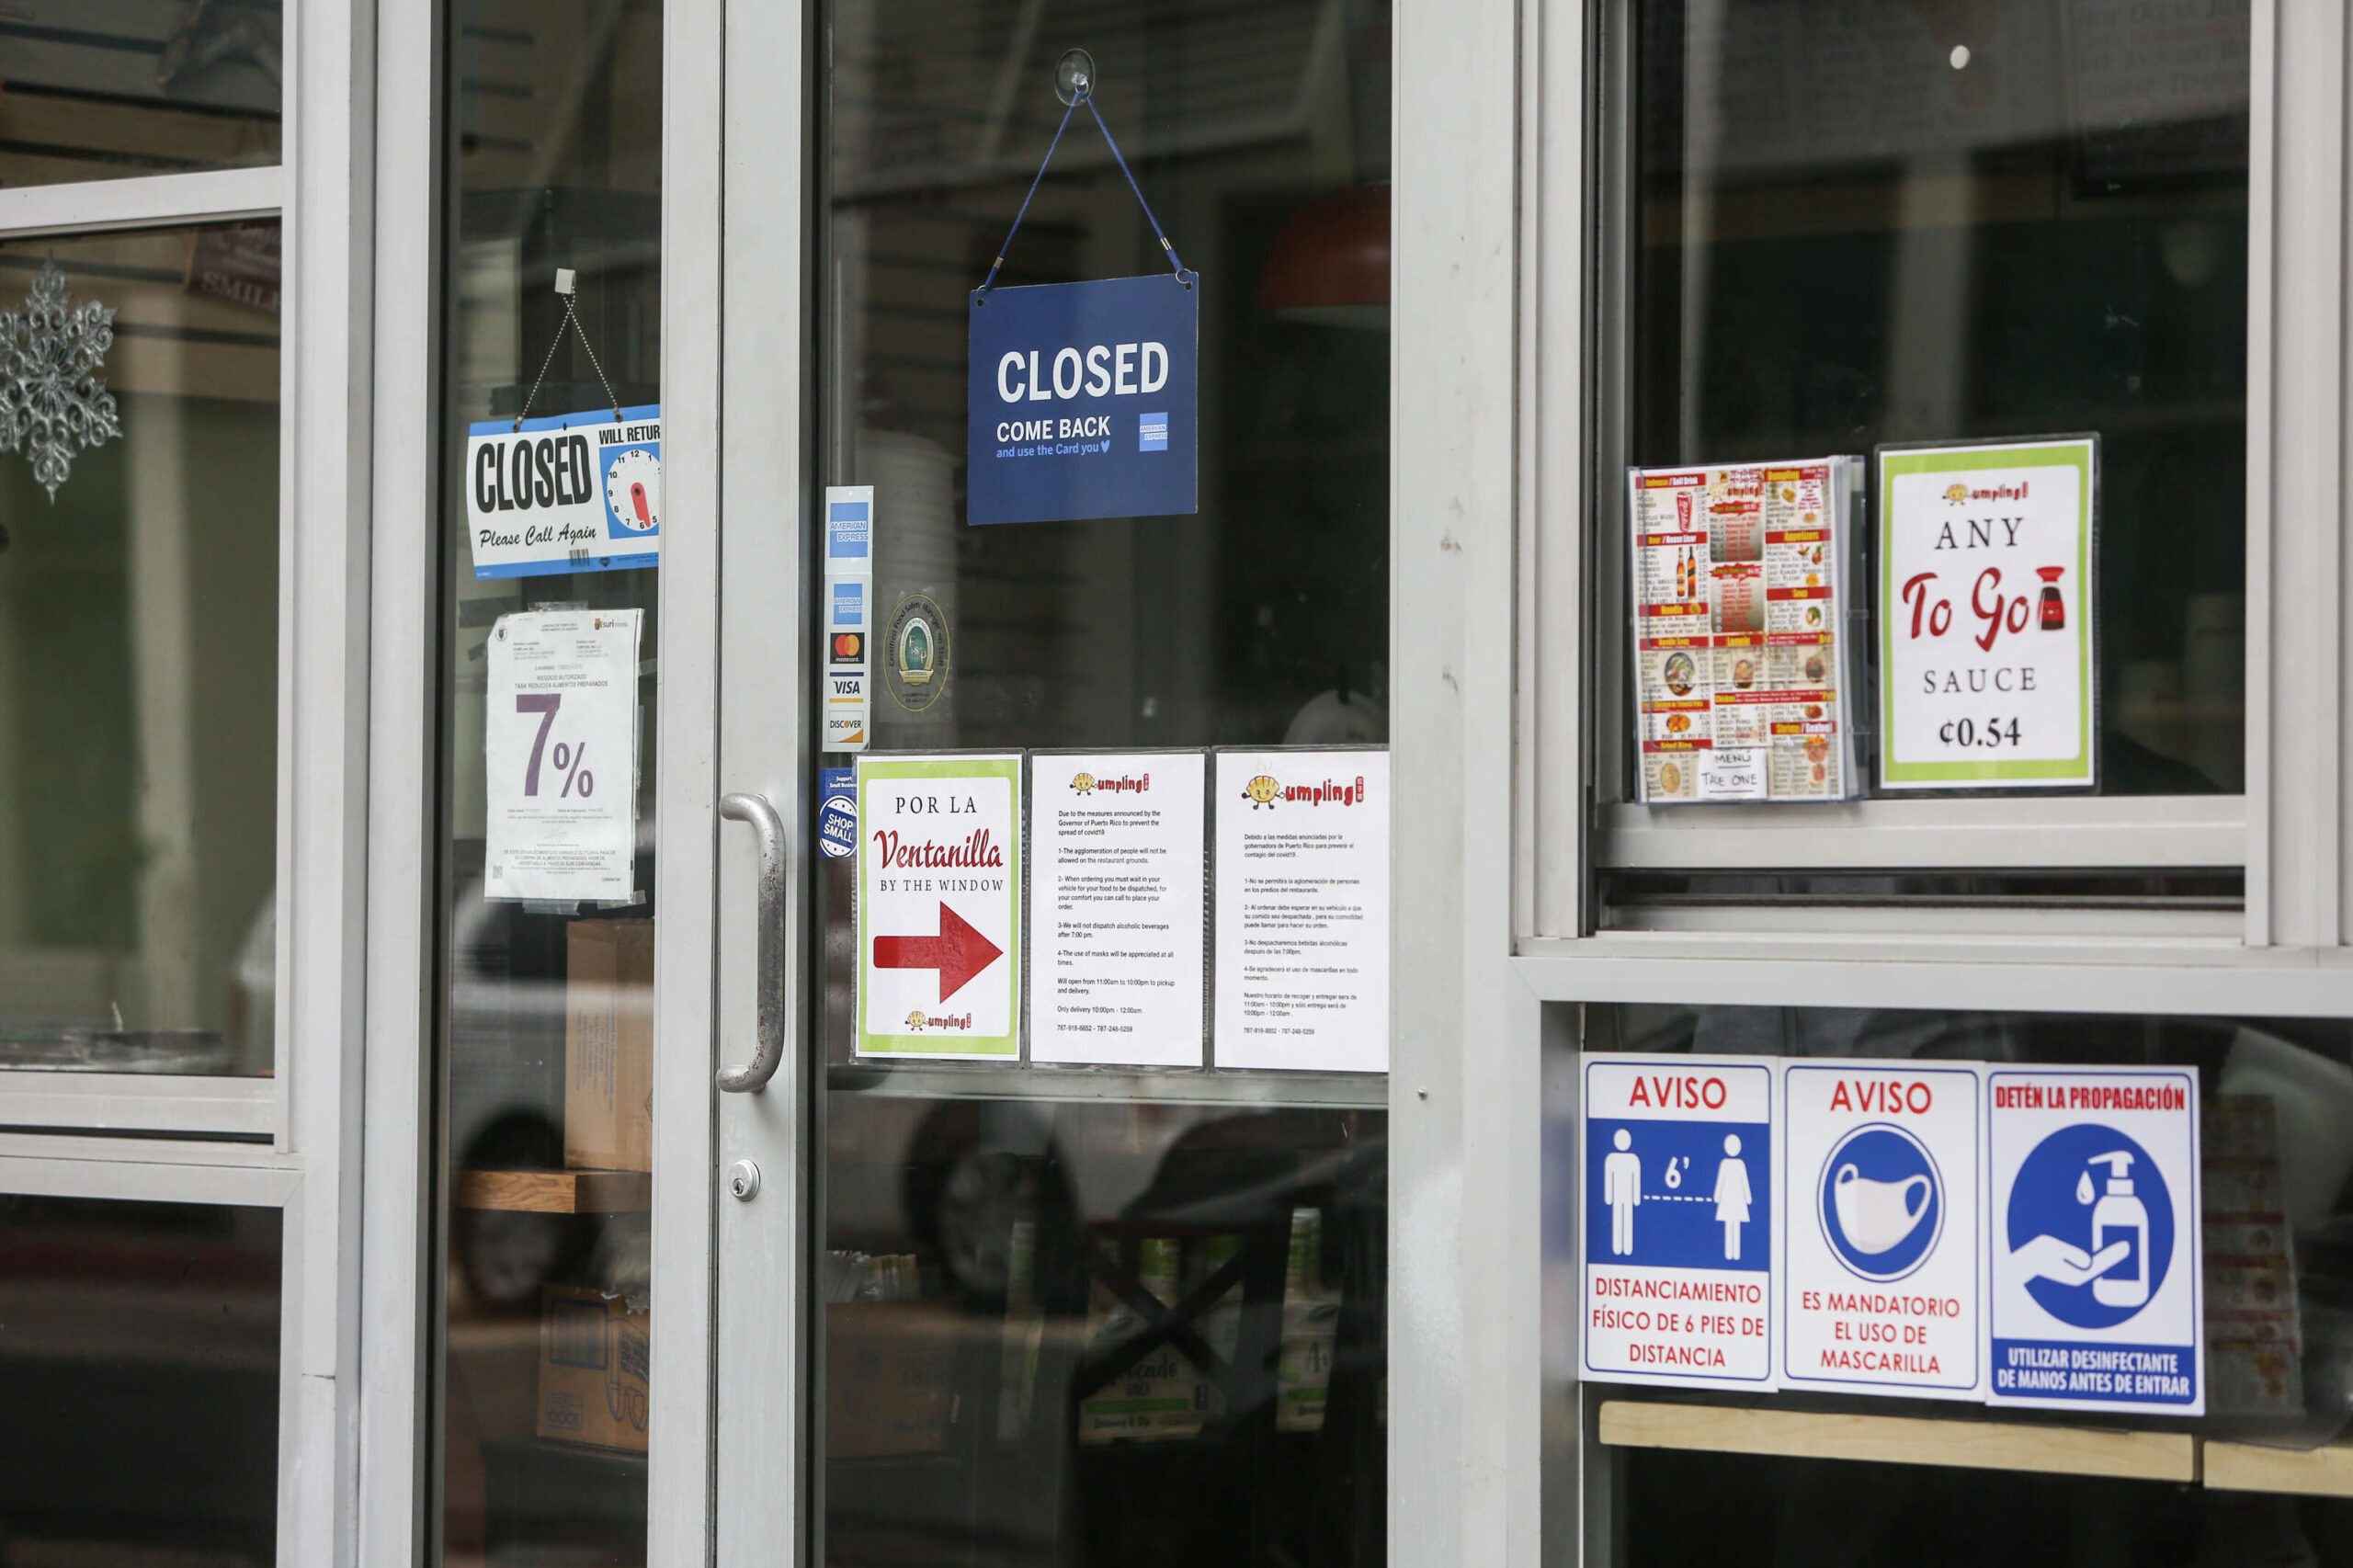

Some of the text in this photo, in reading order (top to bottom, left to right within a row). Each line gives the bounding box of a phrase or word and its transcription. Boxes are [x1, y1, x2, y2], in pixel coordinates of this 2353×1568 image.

[997, 342, 1169, 403] CLOSED
[599, 428, 624, 445] WILL
[996, 416, 1111, 442] COME BACK
[996, 443, 1098, 458] and use the Card you
[476, 435, 592, 514] CLOSED
[480, 523, 597, 548] Please Call Again
[830, 522, 866, 530] AMERICAN
[837, 533, 869, 541] EXPRESS
[1935, 517, 2024, 550] ANY
[1903, 566, 2029, 653] To Go
[602, 619, 615, 628] suri
[834, 681, 860, 694] VISA
[1924, 667, 2037, 694] SAUCE
[830, 720, 862, 728] DISCOVER
[1939, 717, 2022, 747] ¢0.54
[516, 693, 594, 798] 7%
[895, 796, 977, 813] POR LA
[824, 824, 853, 844] SMALL
[828, 813, 853, 831] SHOP
[873, 828, 1004, 869] Ventanilla
[881, 880, 1004, 892] BY THE WINDOW
[1629, 1076, 1727, 1109] AVISO
[1830, 1080, 1932, 1114] AVISO
[1996, 1083, 2185, 1110] DETÉN LA PROPAGACIÓN
[1596, 1278, 1761, 1304] DISTANCIAMIENTO
[1802, 1291, 1961, 1318] ES MANDATORIO
[1593, 1304, 1764, 1336] FÍSICO DE 6 PIES DE
[1835, 1322, 1927, 1345] EL USO DE
[1629, 1344, 1726, 1368] DISTANCIA
[1821, 1349, 1940, 1374] MASCARILLA
[2008, 1347, 2177, 1373] UTILIZAR DESINFECTANTE
[1998, 1368, 2190, 1396] DE MANOS ANTES DE ENTRAR
